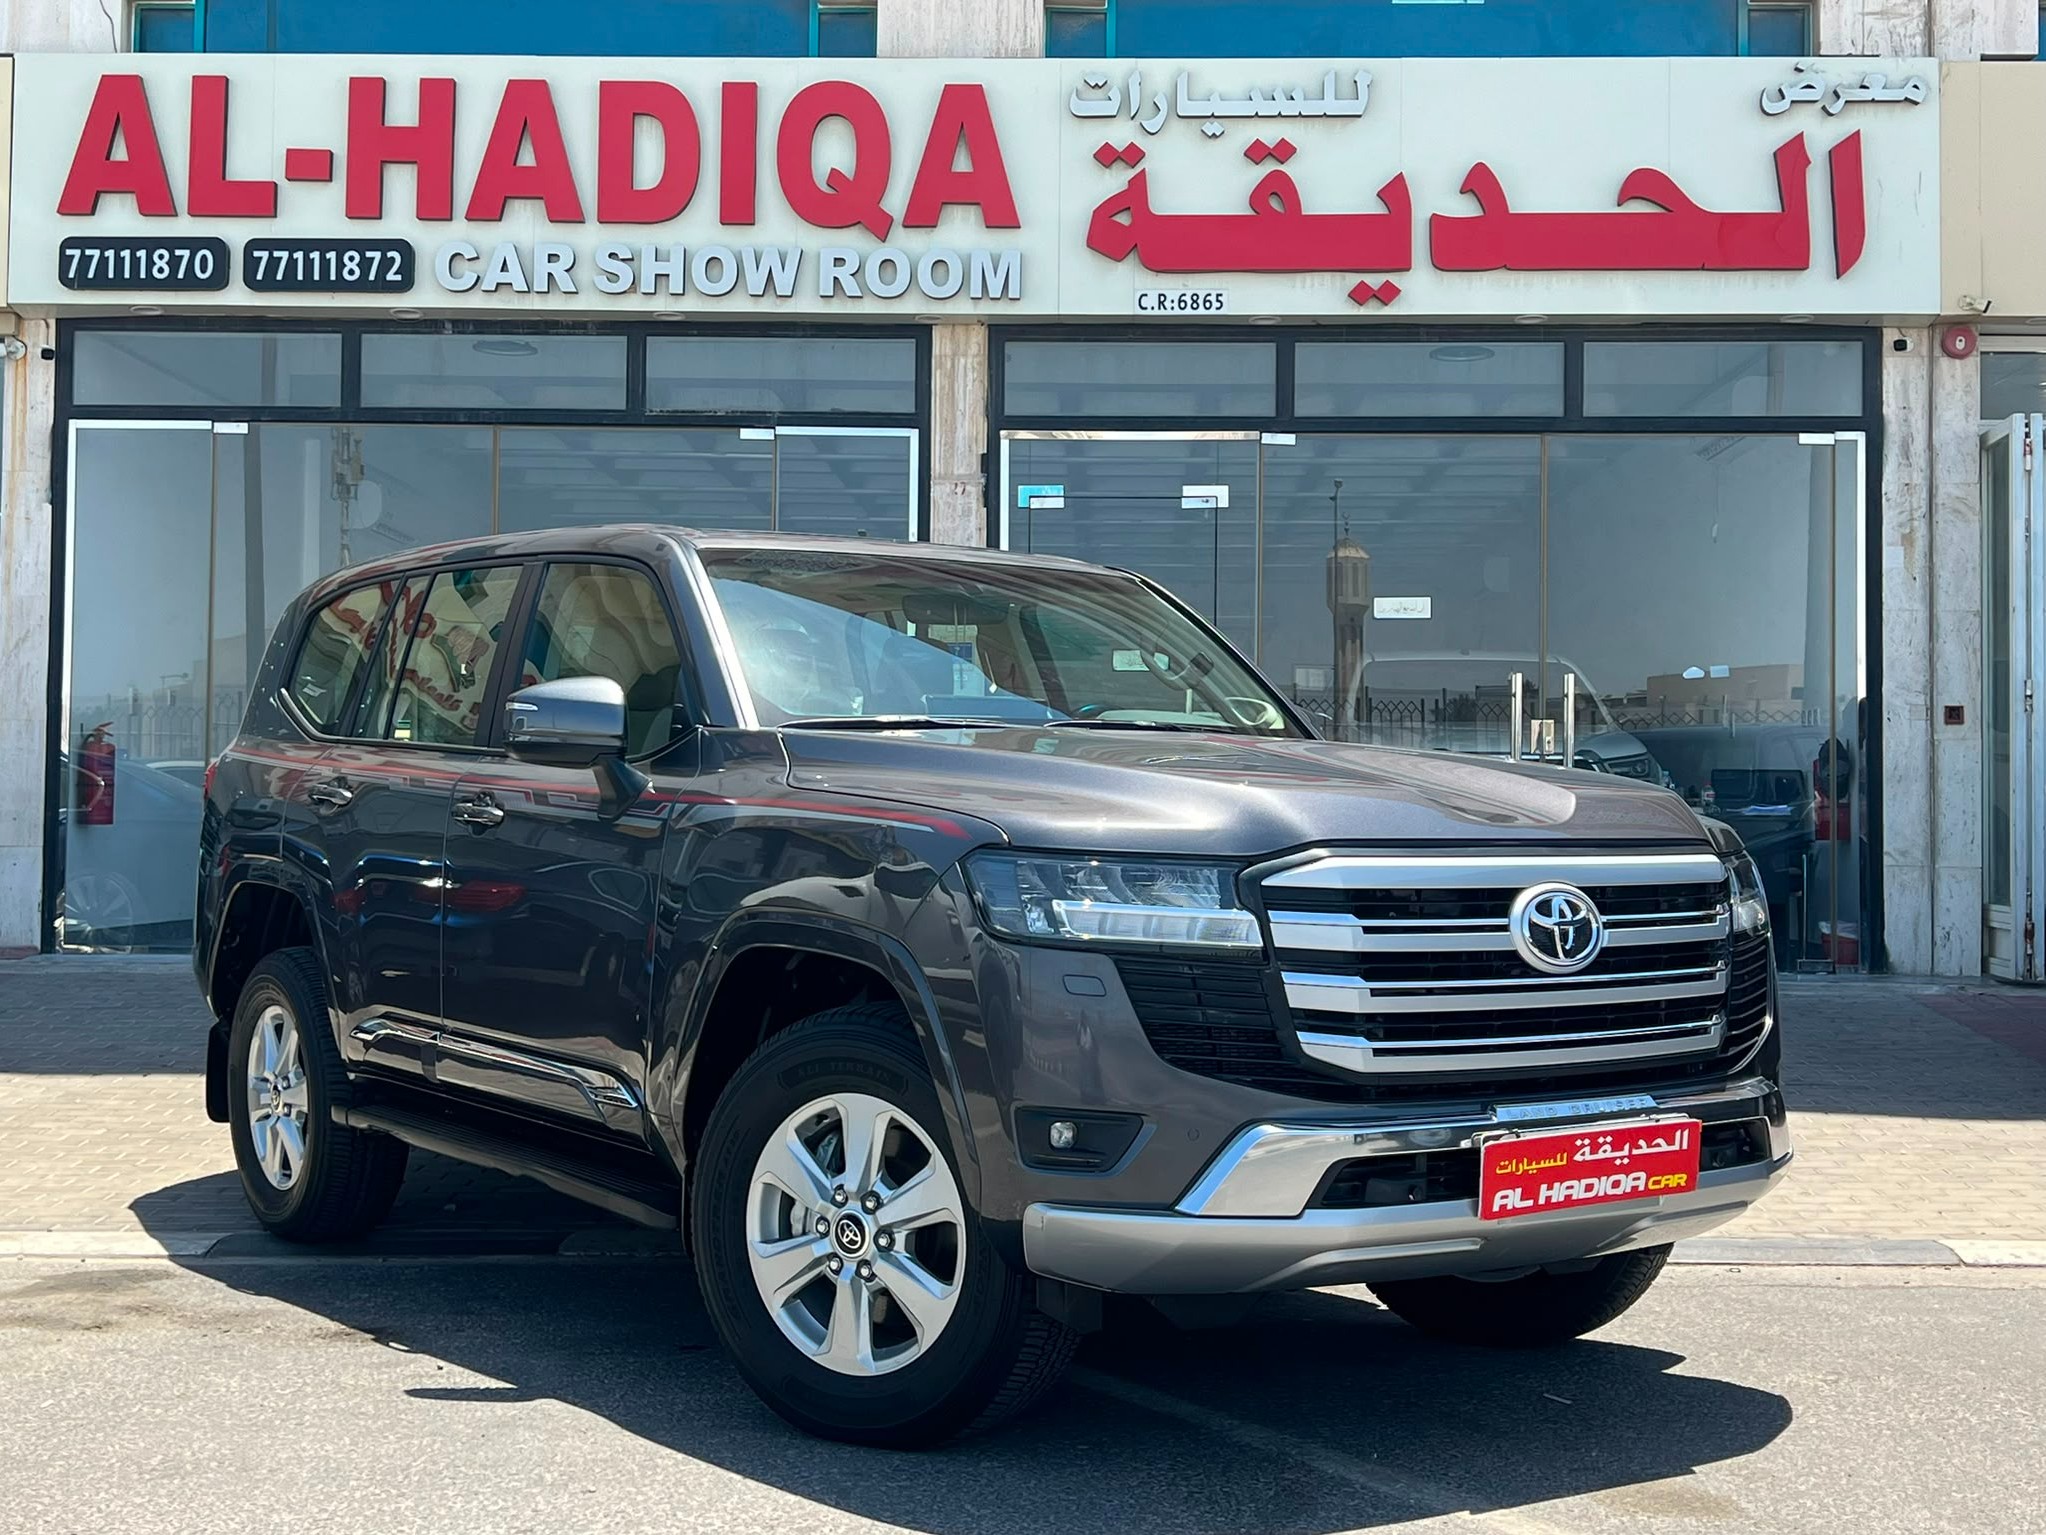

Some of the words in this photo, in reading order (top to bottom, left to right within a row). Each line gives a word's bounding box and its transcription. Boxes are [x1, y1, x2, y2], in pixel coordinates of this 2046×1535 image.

[1069, 69, 1374, 137] للسيارات
[1759, 61, 1928, 117] معرض
[57, 74, 1021, 242] AL-HADIQA
[1086, 128, 1866, 308] الحديقة
[64, 248, 214, 280] 77111870
[252, 250, 403, 281] 77111872
[434, 242, 579, 295] CAR
[593, 243, 804, 298] SHOW
[819, 247, 1023, 301] ROOM
[1137, 292, 1225, 311] C.R:6865
[1495, 1151, 1568, 1176] للسيارات
[1573, 1128, 1690, 1166] الحديقة
[1492, 1187, 1534, 1212] AL
[1538, 1171, 1648, 1205] HADIQA
[1647, 1173, 1688, 1190] CAR
